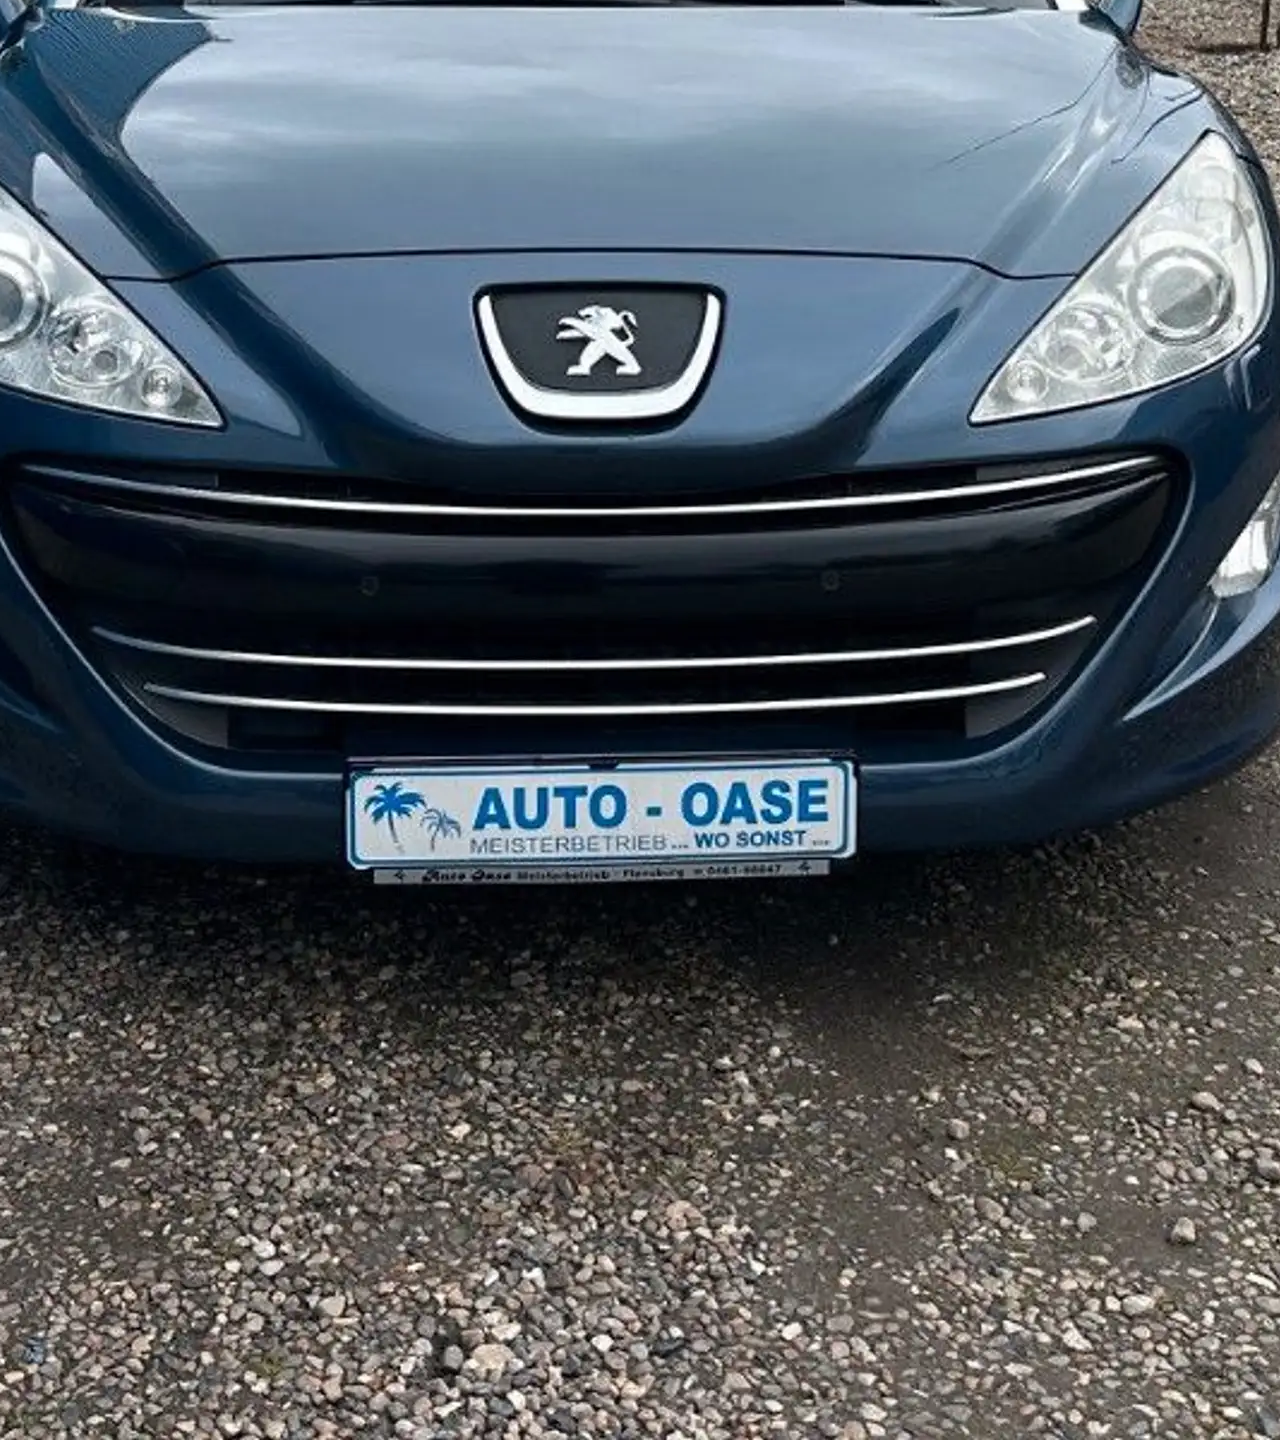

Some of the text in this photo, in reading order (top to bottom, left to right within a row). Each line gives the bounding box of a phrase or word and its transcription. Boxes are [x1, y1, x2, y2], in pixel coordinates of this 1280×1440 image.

[472, 784, 627, 831] AUTO
[681, 778, 830, 827] OASE
[694, 831, 731, 850] WO
[736, 829, 808, 848] SONST
